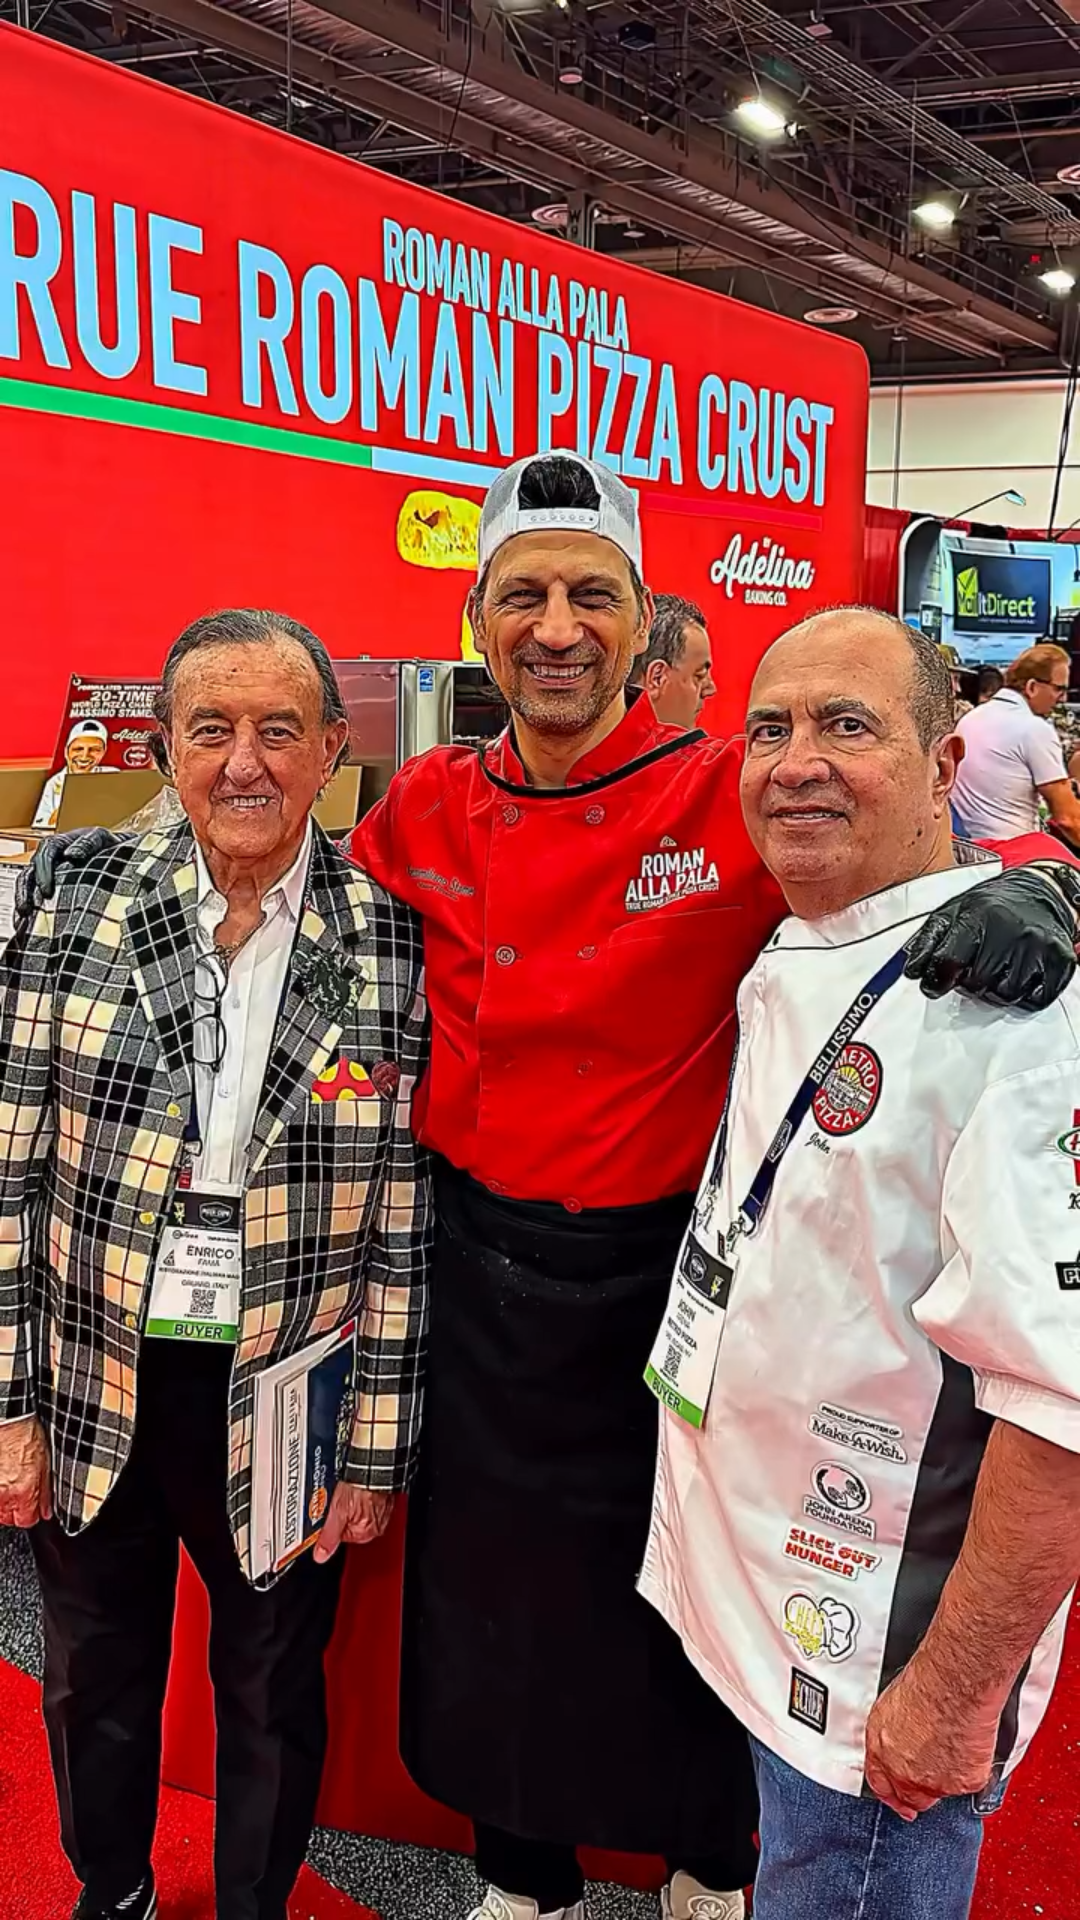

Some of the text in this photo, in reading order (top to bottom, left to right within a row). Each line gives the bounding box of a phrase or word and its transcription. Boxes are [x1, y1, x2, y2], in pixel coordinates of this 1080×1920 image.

[383, 218, 629, 351] ROMAN ALLA PALA
[238, 240, 513, 456] ROMAN
[538, 330, 682, 485] PIZZA
[699, 374, 834, 506] CRUST
[710, 533, 815, 598] Adelina
[90, 691, 157, 702] 20-TIME
[69, 709, 116, 718] MASSIMO
[641, 847, 705, 878] ROMAN
[625, 862, 720, 902] ALLA PALA
[835, 1050, 877, 1088] METRO
[804, 1131, 831, 1155] John
[186, 1245, 235, 1260] ENRICO
[677, 1298, 697, 1322] JOHN
[174, 1323, 223, 1339] BUYER
[651, 1376, 682, 1411] BUYER
[820, 1406, 846, 1422] PROUD
[846, 1413, 889, 1434] SUPPORTER
[284, 1435, 300, 1549] RISTORAZIONE
[805, 1499, 873, 1531] JOHN ARENA
[805, 1507, 873, 1538] FOUNDATION
[784, 1542, 855, 1578] HUNGER
[789, 1528, 877, 1570] SLICE OUT
